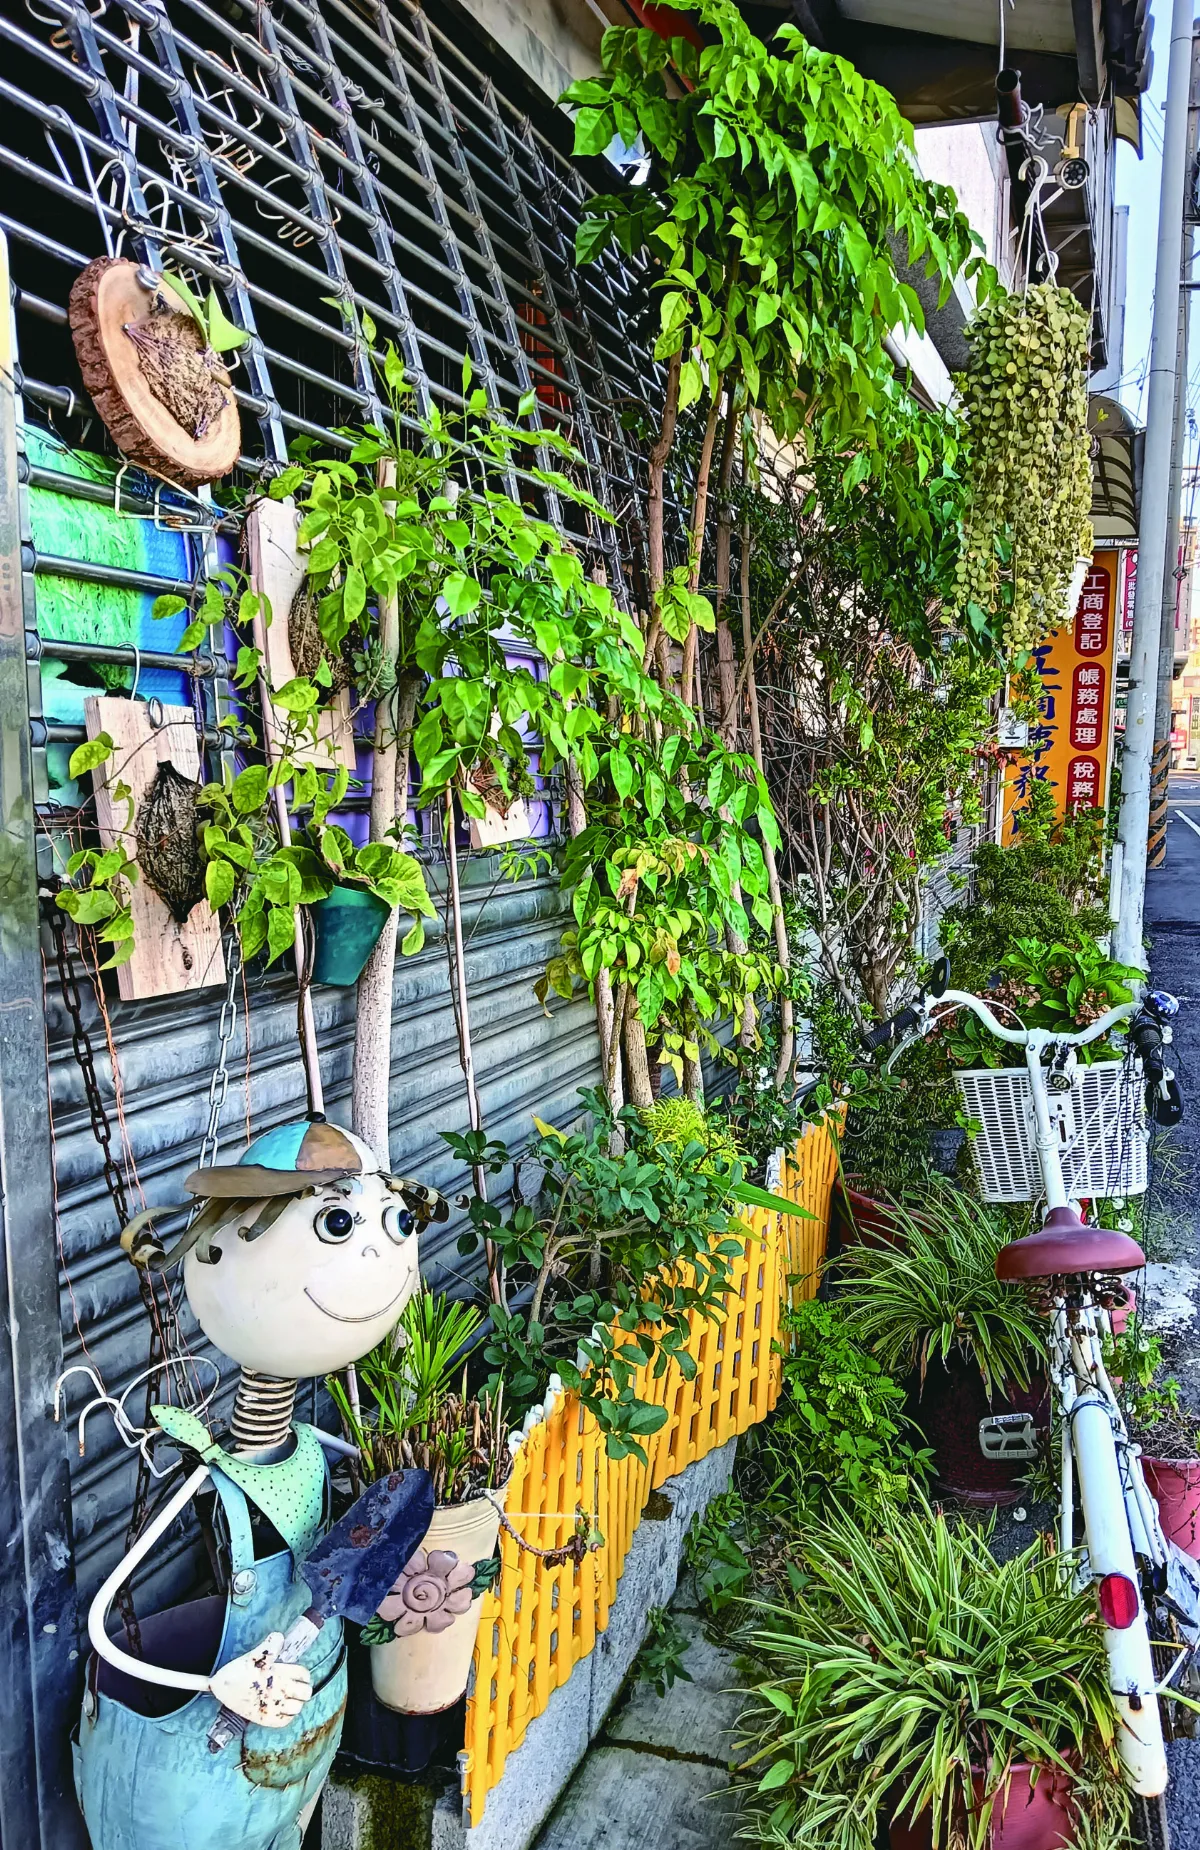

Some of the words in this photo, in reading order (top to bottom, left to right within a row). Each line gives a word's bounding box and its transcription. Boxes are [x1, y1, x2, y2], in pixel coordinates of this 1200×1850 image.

[1080, 574, 1105, 650] 工商登記
[1075, 668, 1100, 744] 帳務處理
